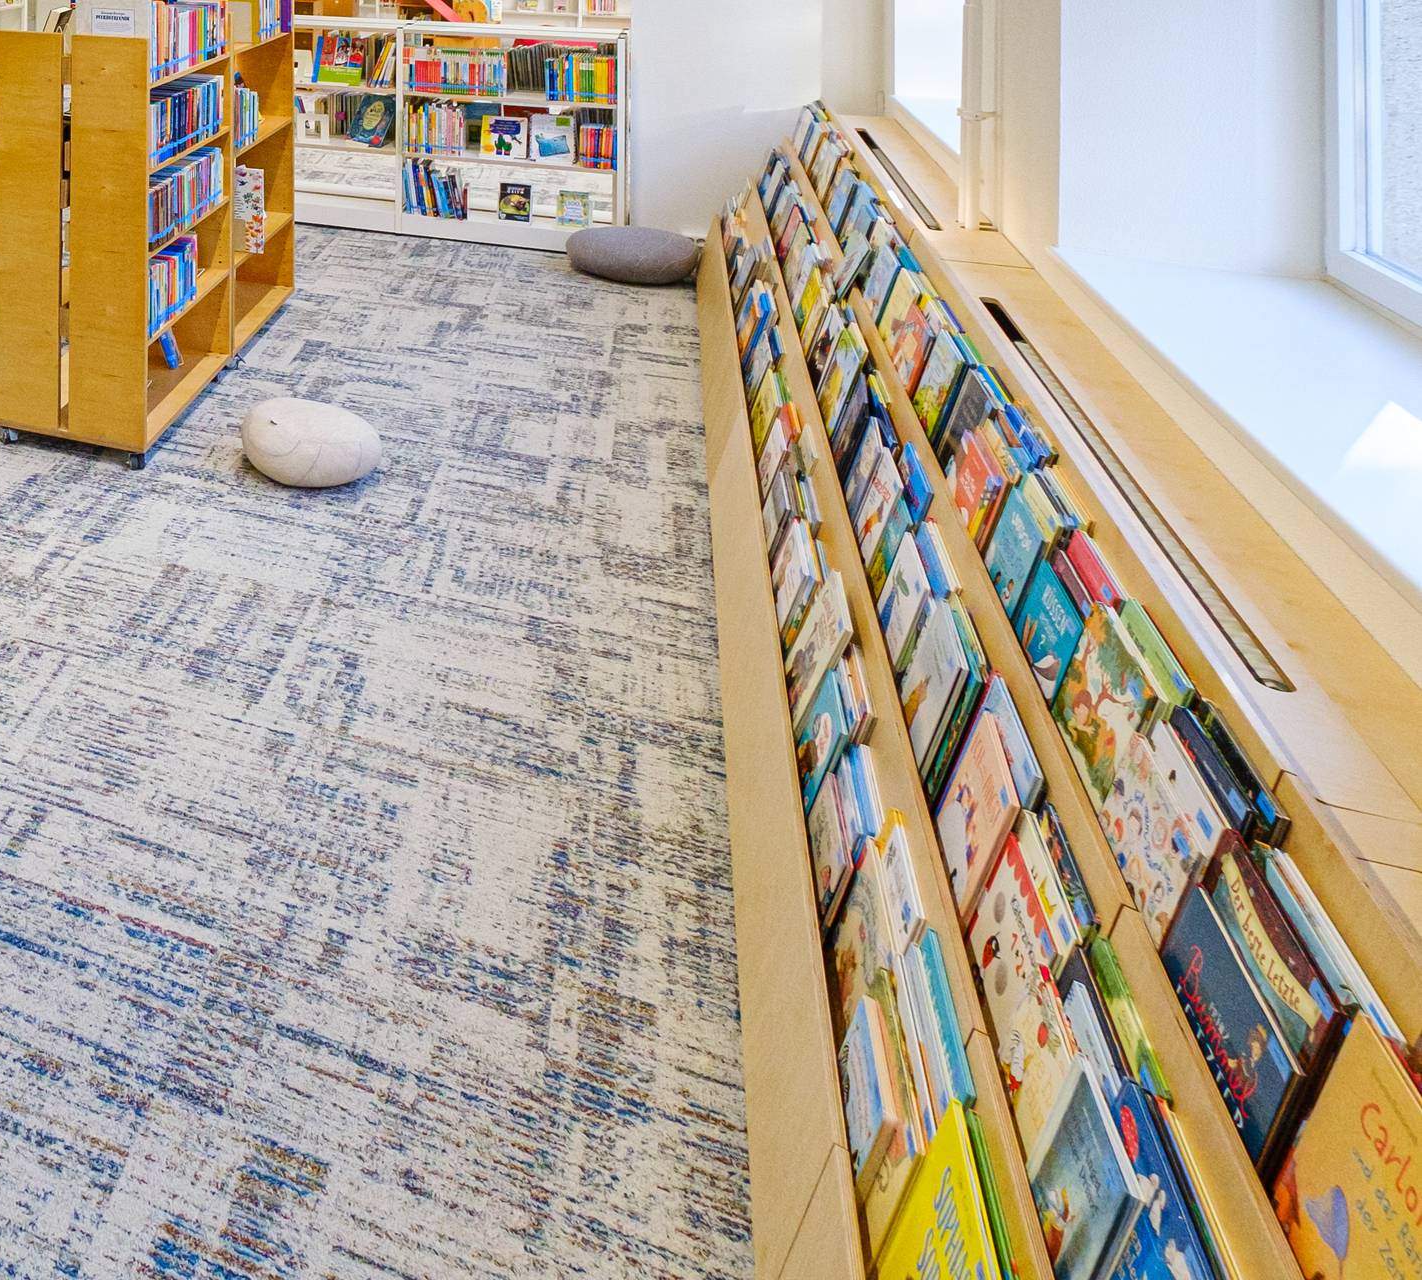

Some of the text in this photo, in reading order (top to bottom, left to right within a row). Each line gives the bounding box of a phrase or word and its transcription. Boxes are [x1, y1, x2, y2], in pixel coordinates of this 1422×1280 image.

[1229, 877, 1305, 1012] Der beste Letzte
[1360, 1102, 1422, 1228] Carlo
